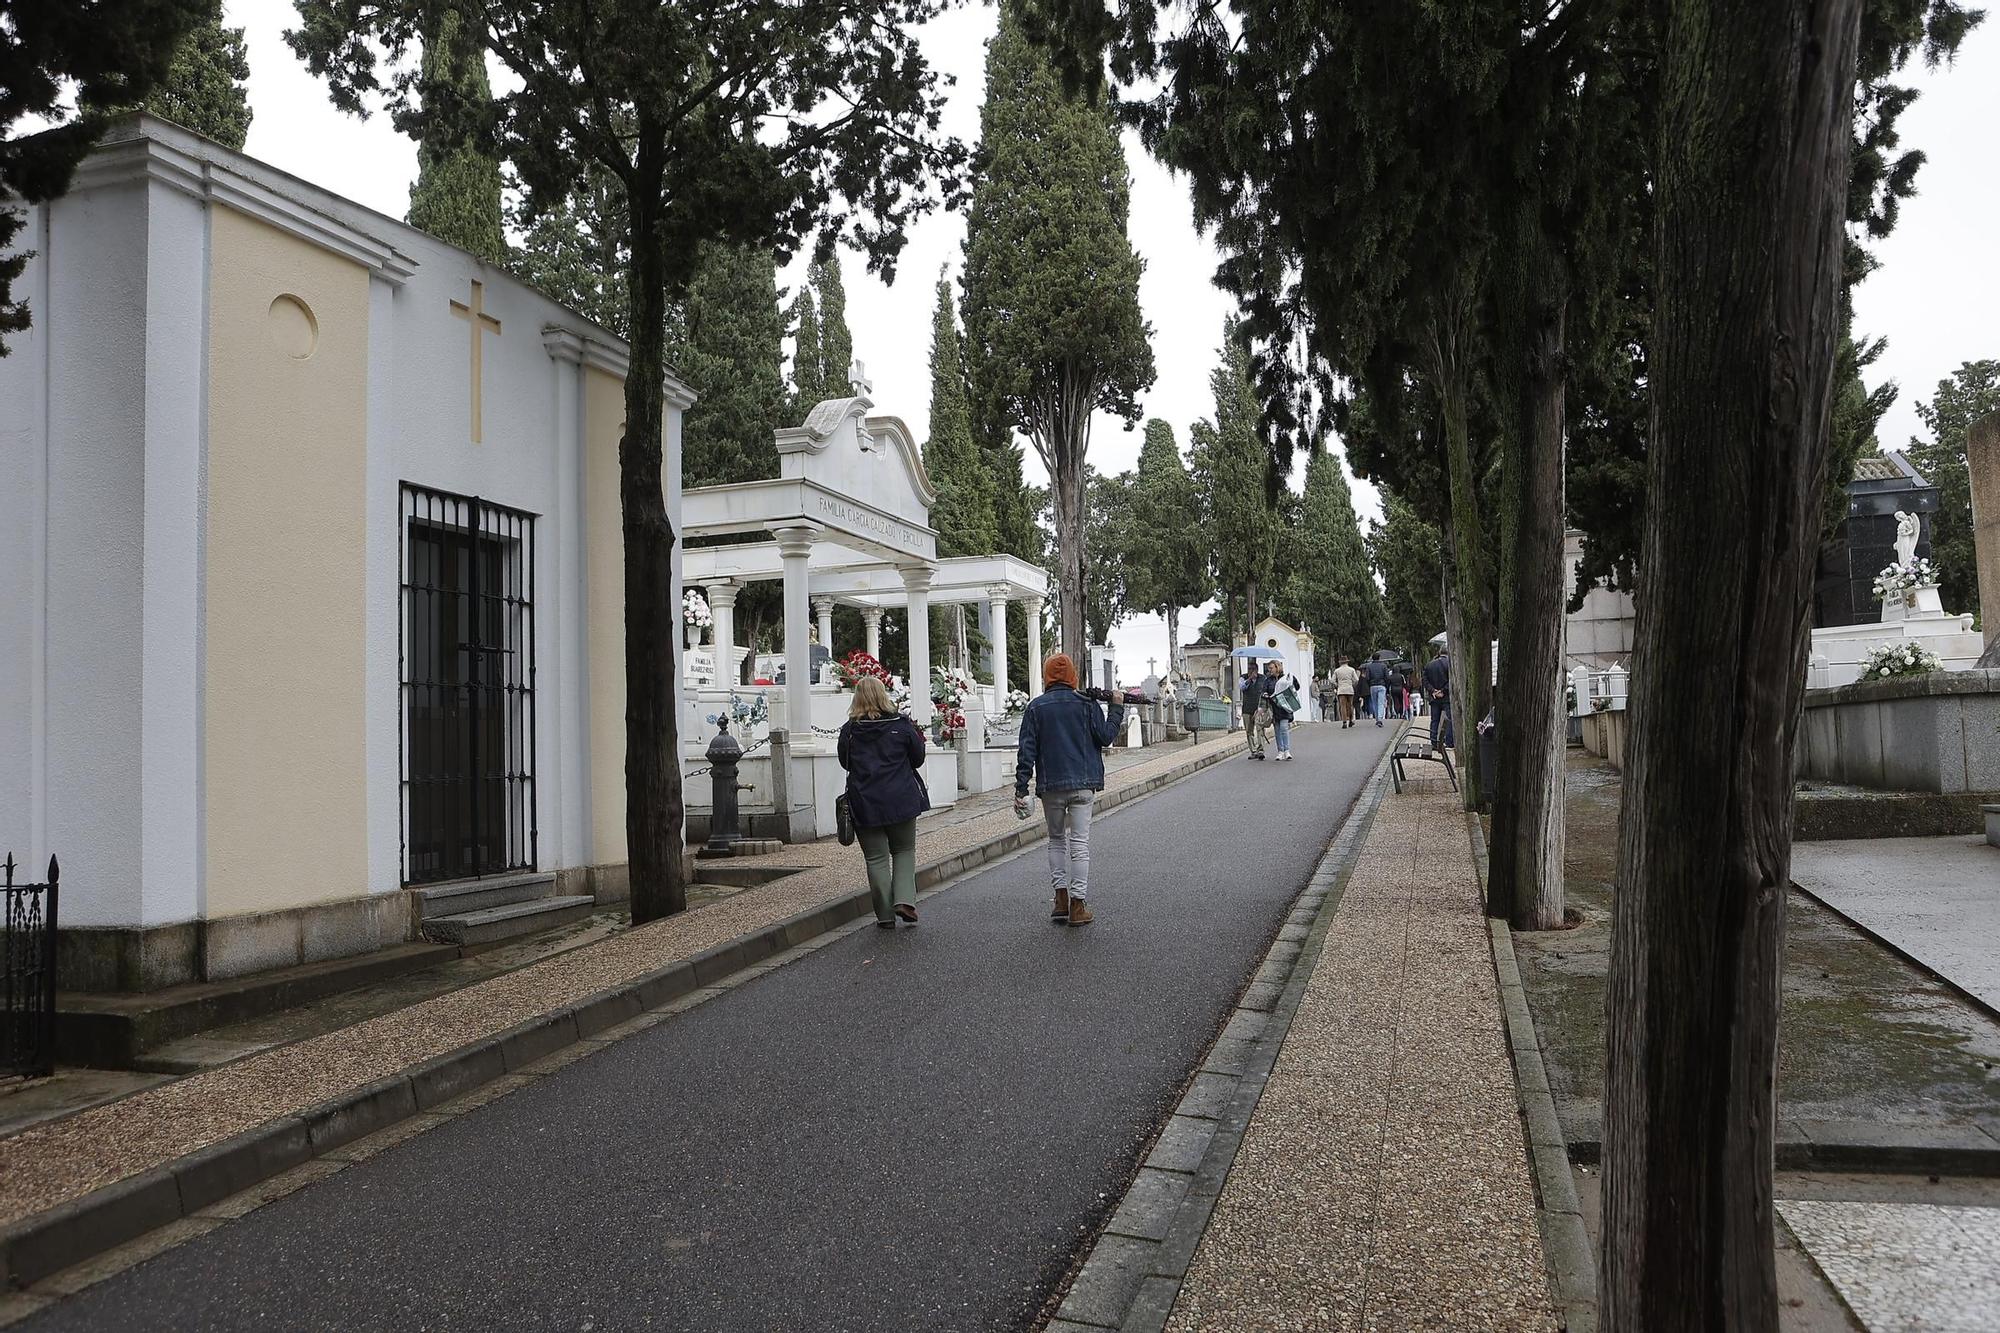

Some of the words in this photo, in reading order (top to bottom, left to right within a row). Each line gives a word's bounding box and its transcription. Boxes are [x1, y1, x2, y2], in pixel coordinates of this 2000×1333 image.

[819, 497, 845, 520] FAMILIA
[871, 518, 896, 538] CALZADO
[897, 529, 902, 540] Y
[695, 657, 711, 665] FAMILIA
